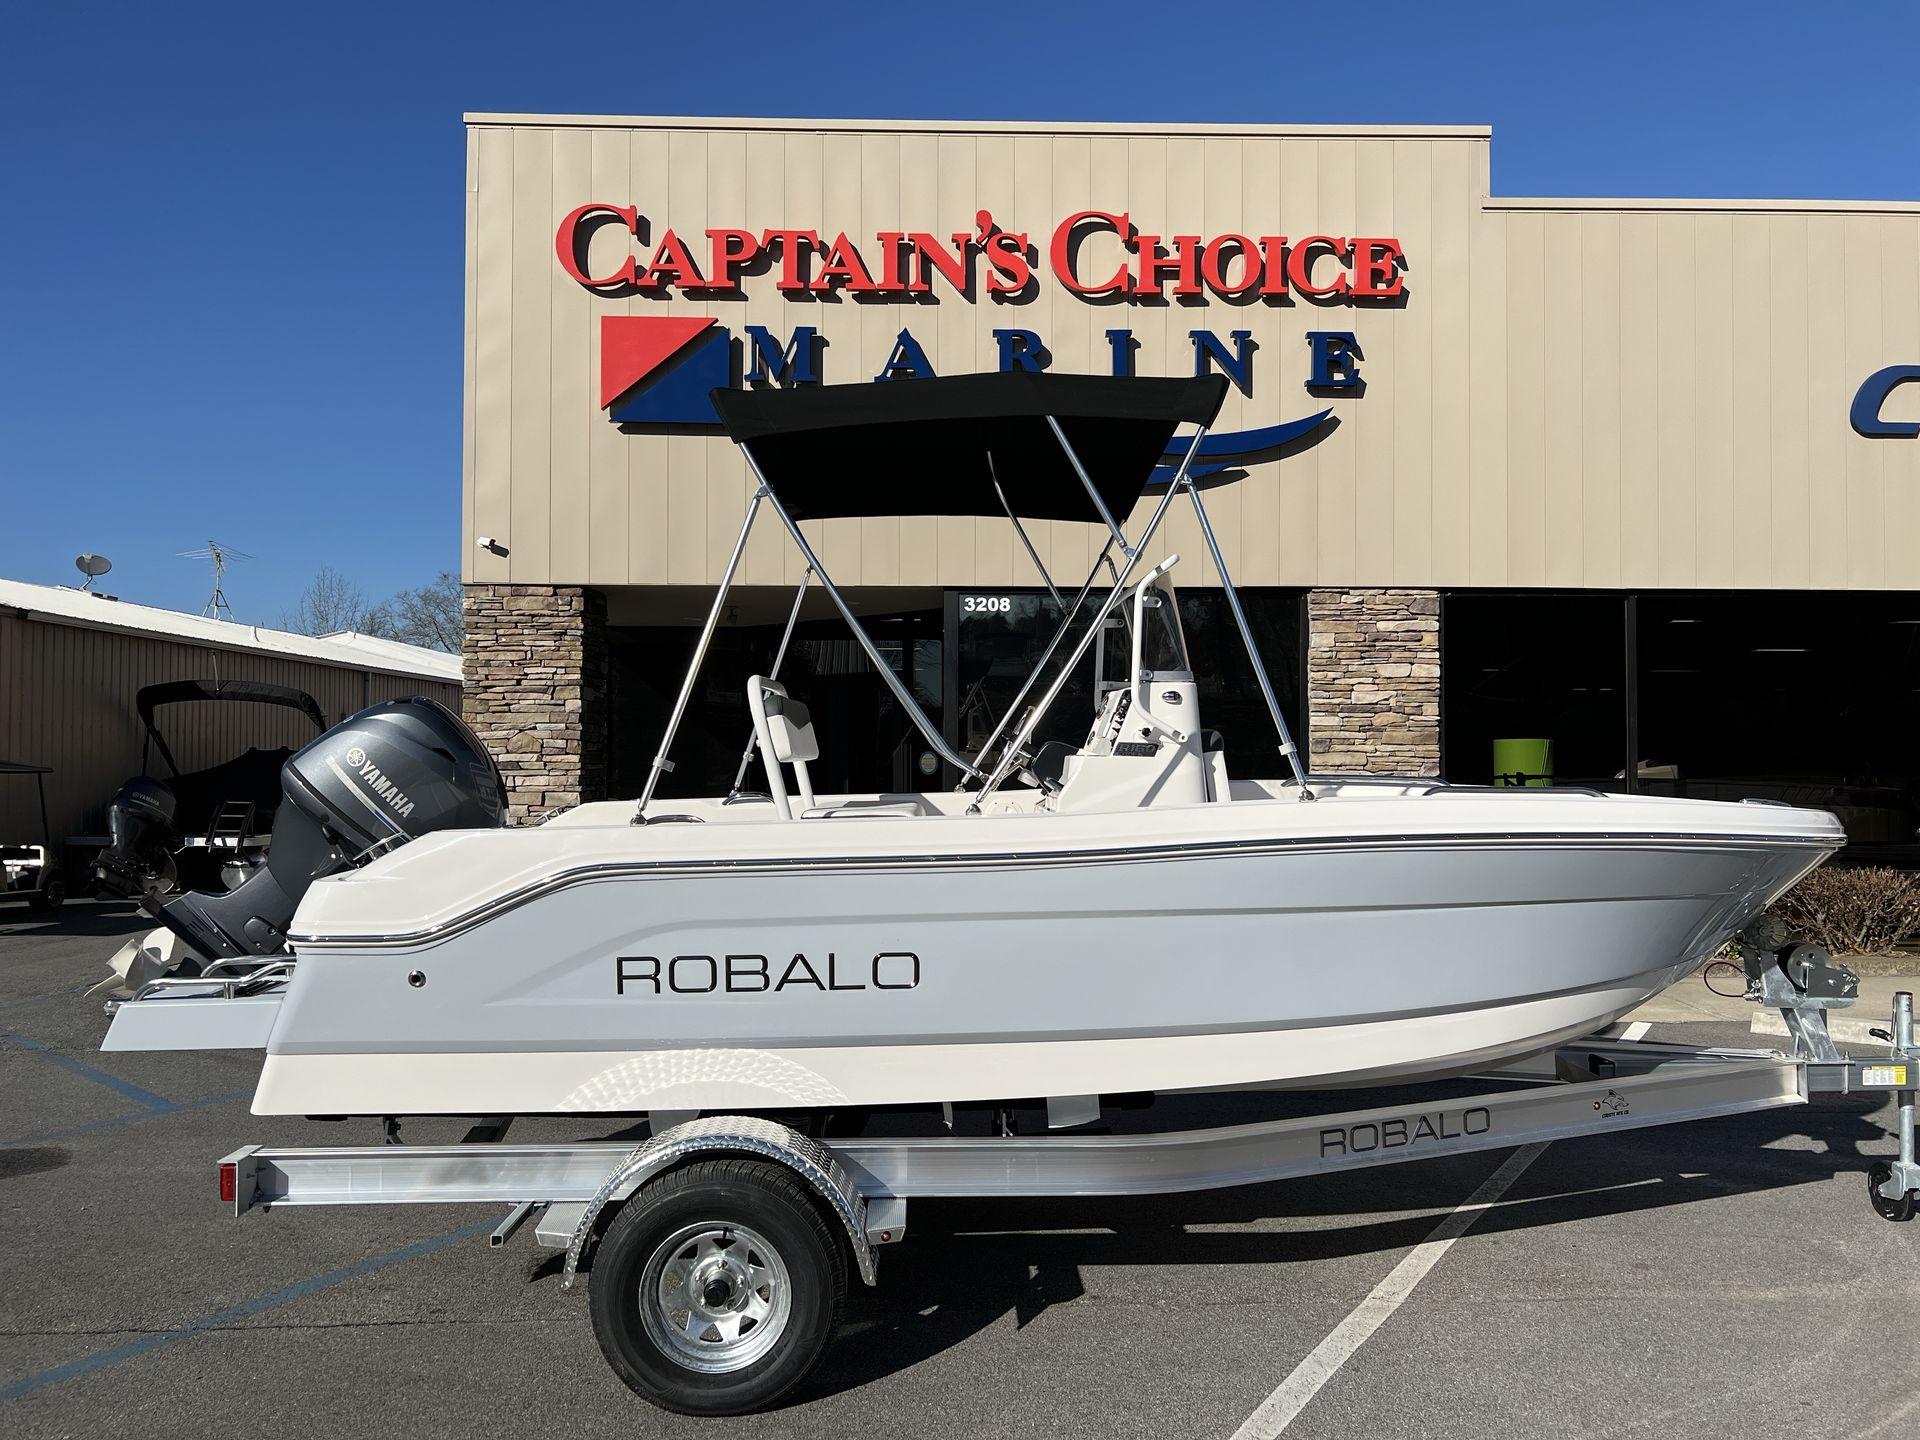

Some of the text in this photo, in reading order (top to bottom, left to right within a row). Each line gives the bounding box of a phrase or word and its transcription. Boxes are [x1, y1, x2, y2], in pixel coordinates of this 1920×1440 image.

[556, 204, 1405, 298] CAPTAIN'S CHOICE
[744, 326, 1361, 390] MARINE
[963, 597, 1011, 612] 3208
[359, 759, 416, 819] YAMAHA
[616, 952, 921, 995] ROBALO
[1319, 1106, 1491, 1158] ROBALO
